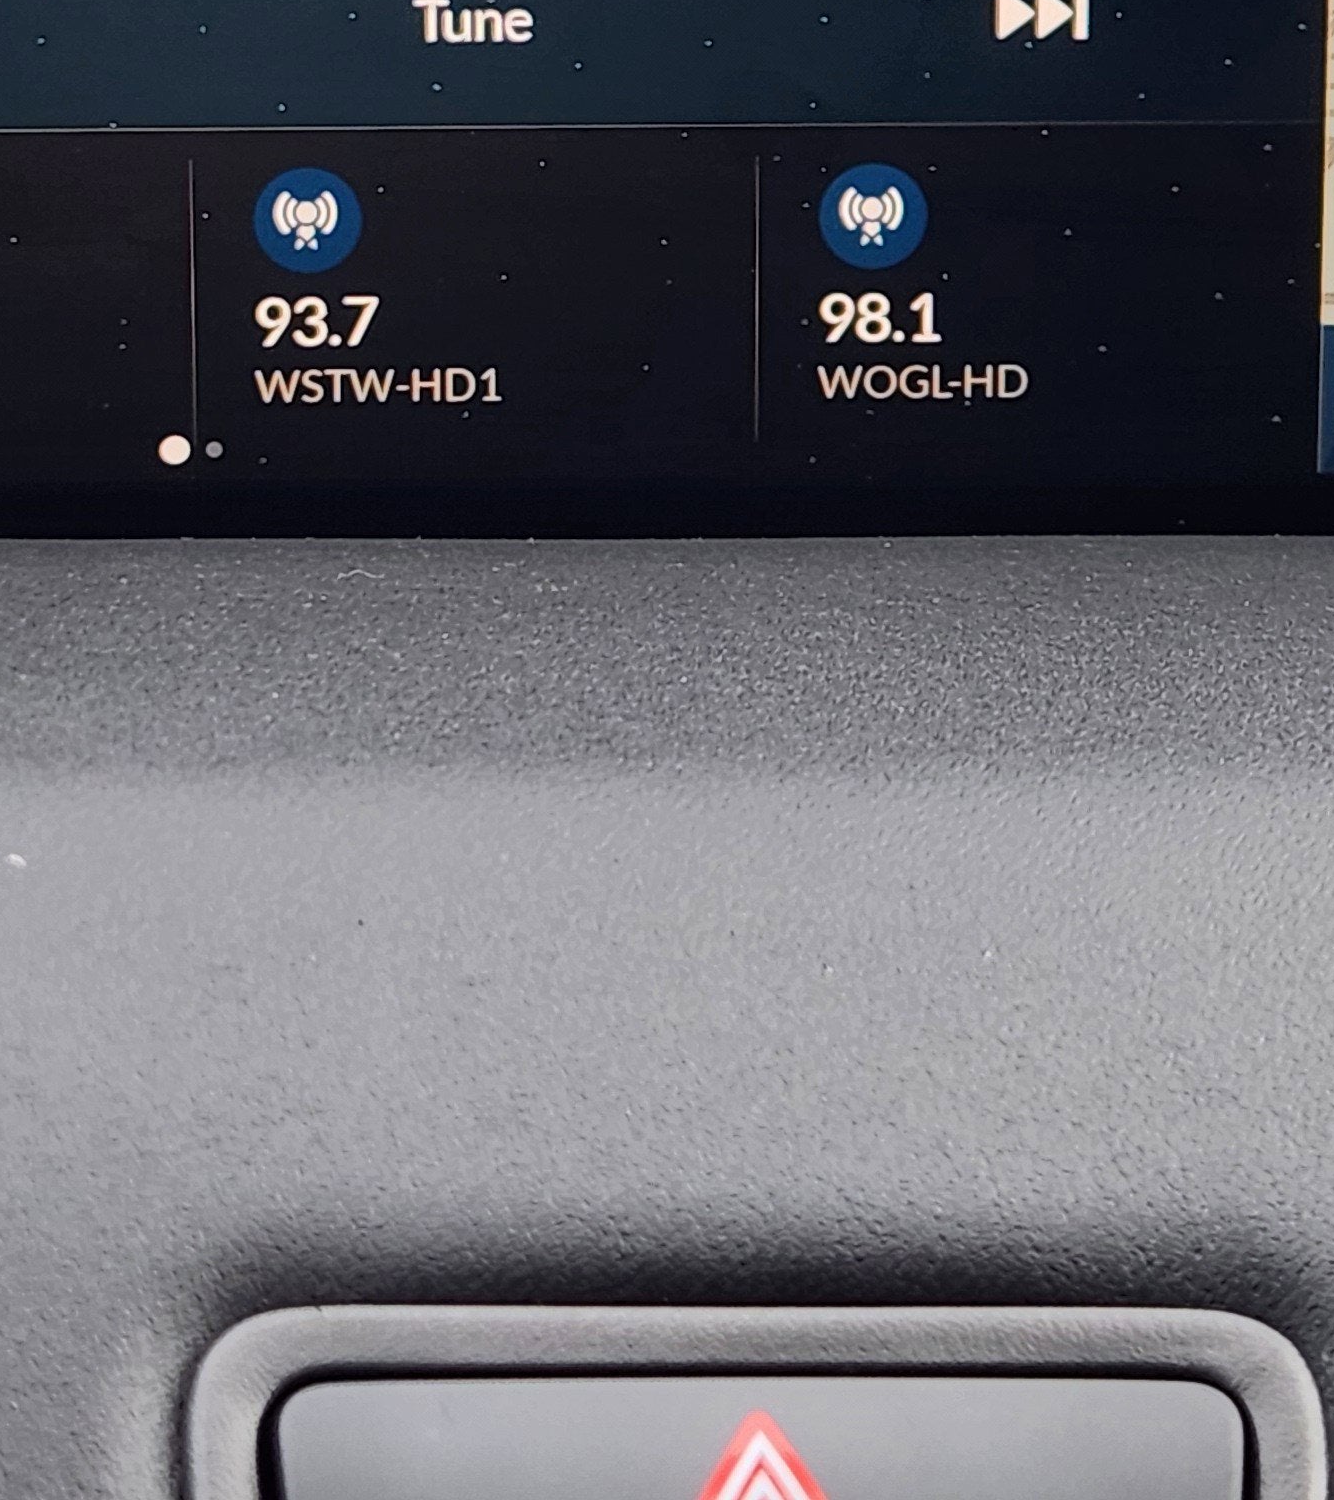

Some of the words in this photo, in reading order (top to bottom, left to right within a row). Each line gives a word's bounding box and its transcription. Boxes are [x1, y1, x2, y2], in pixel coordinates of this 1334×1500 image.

[255, 296, 381, 348] 93.7
[818, 292, 943, 344] 98.1
[254, 367, 503, 404] WSTW-HD1
[817, 364, 1030, 400] WOGL-HD
